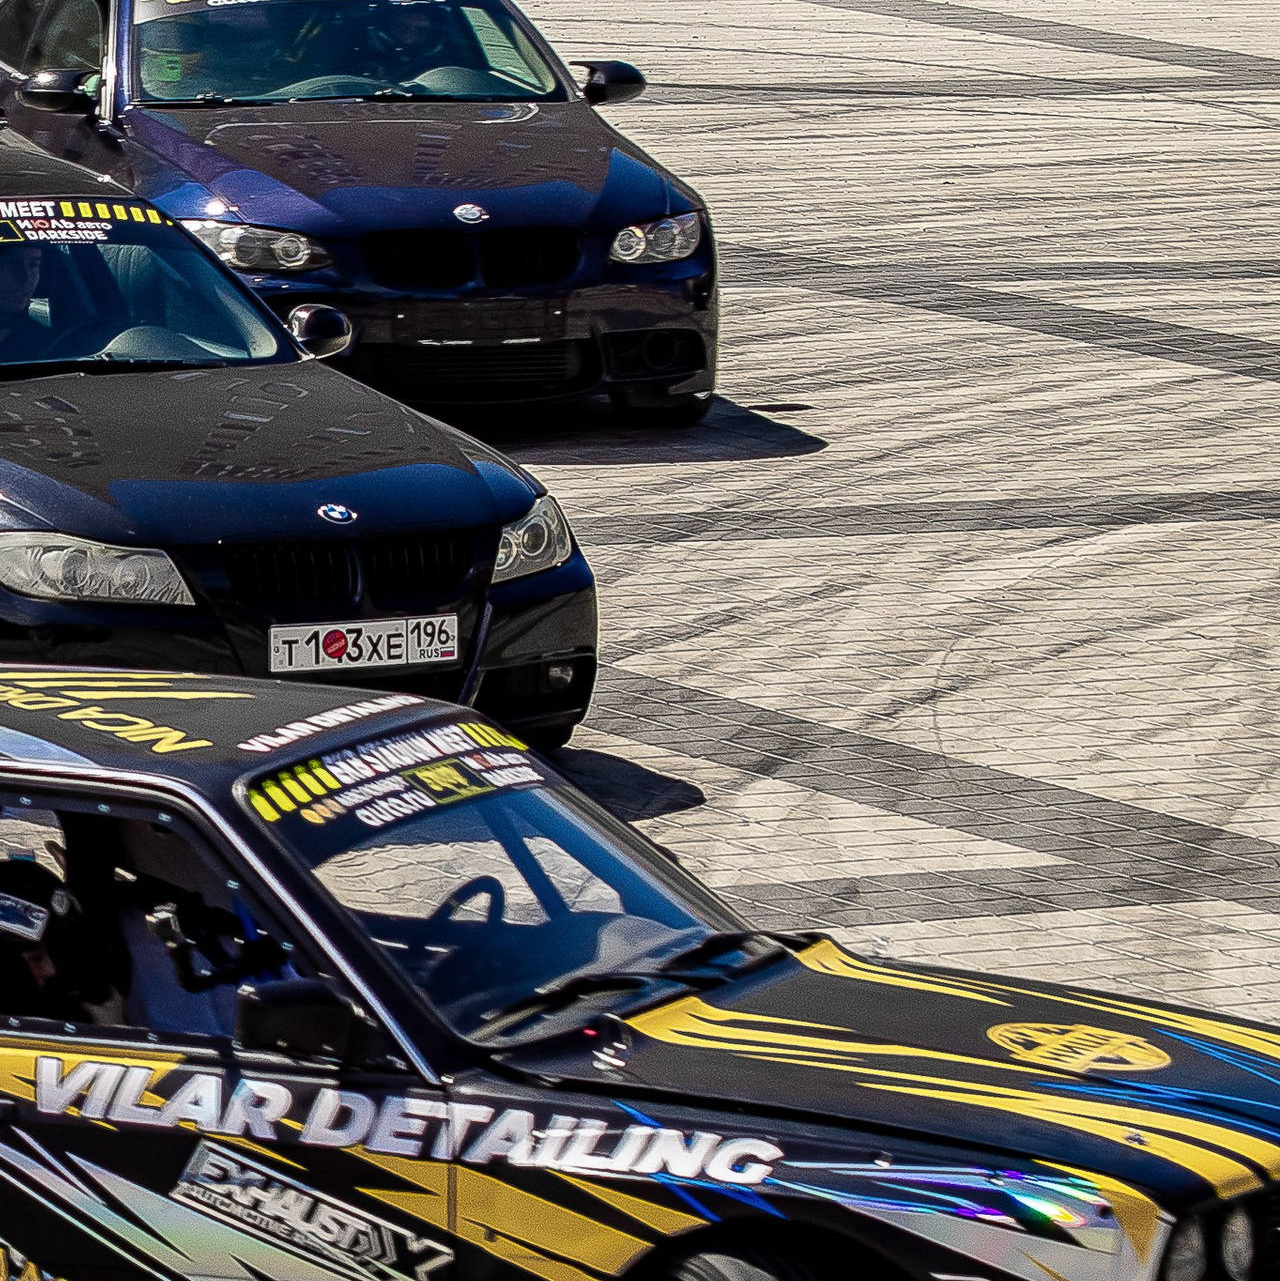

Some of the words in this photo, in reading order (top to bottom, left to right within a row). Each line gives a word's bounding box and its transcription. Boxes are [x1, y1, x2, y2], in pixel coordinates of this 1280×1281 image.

[24, 230, 109, 242] DARKSIDE
[281, 627, 405, 667] T13XE
[410, 619, 450, 648] 196
[419, 648, 440, 659] RUS
[32, 1055, 295, 1141] VILAR
[301, 1088, 786, 1186] DETAILING
